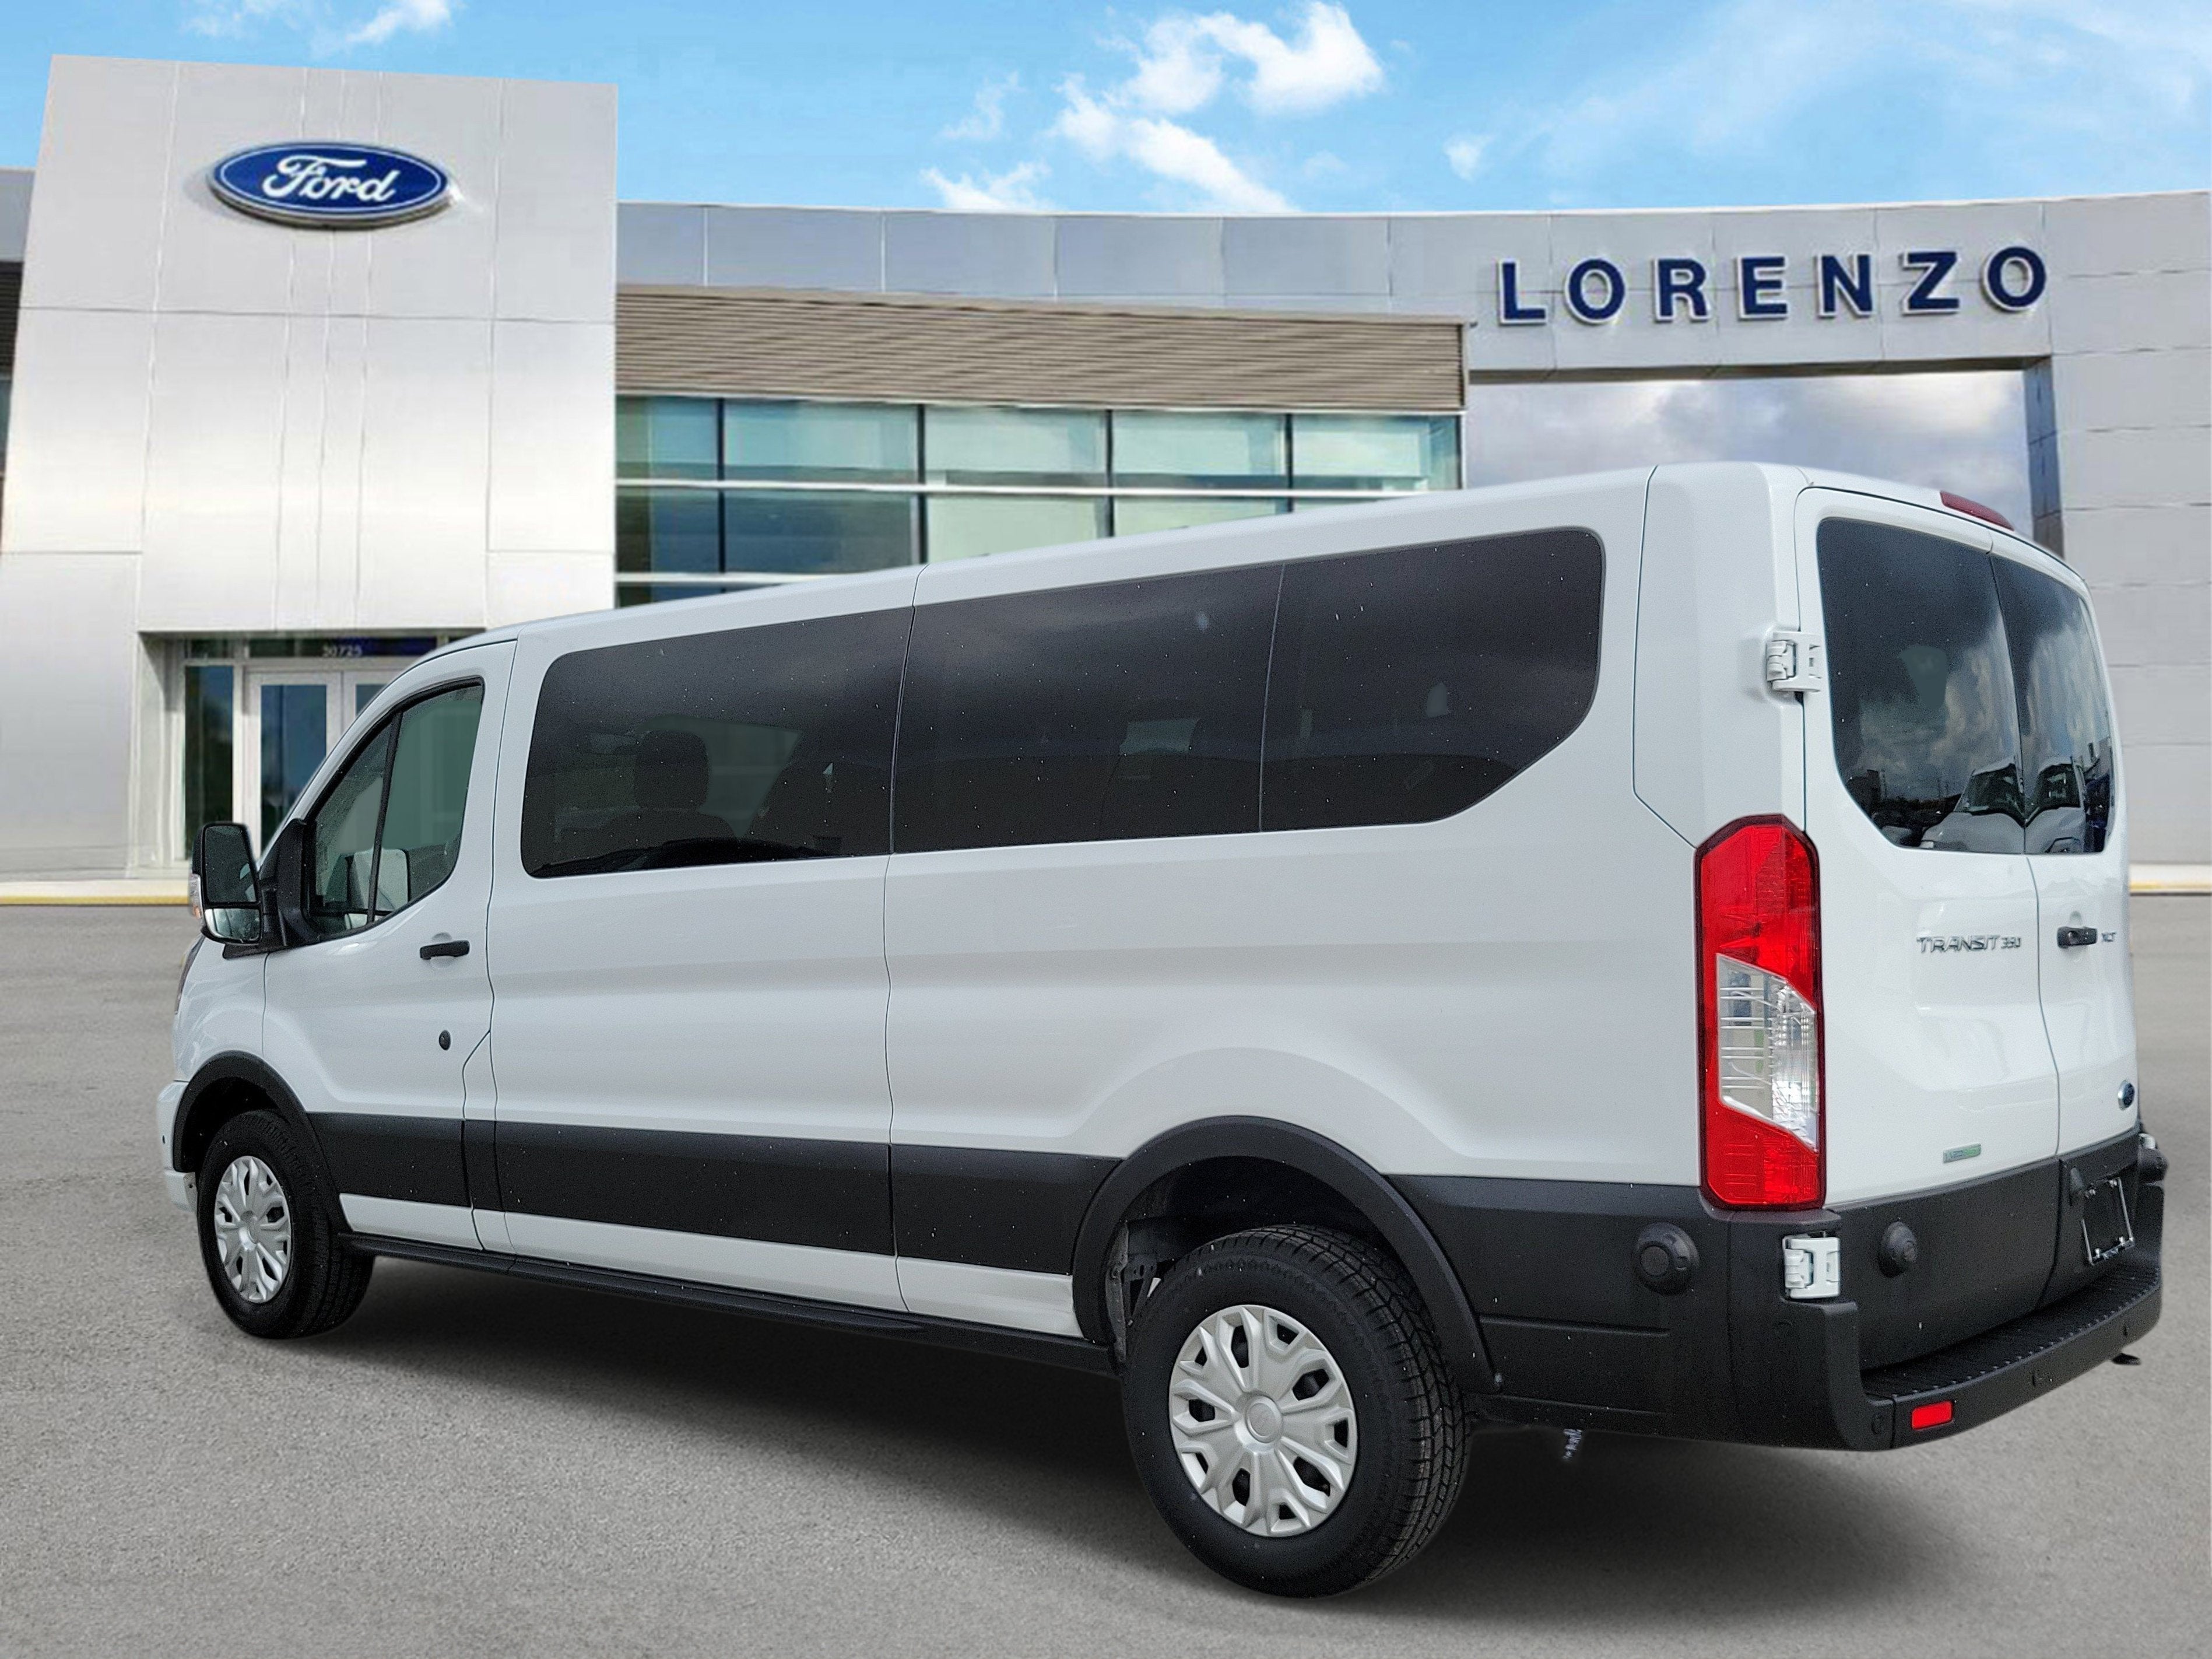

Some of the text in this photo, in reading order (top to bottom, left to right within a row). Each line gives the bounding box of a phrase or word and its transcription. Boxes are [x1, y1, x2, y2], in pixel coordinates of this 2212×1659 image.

[261, 154, 401, 202] Ford
[1498, 246, 2046, 324] LORENZO
[1916, 935, 2000, 953] TRANSIT
